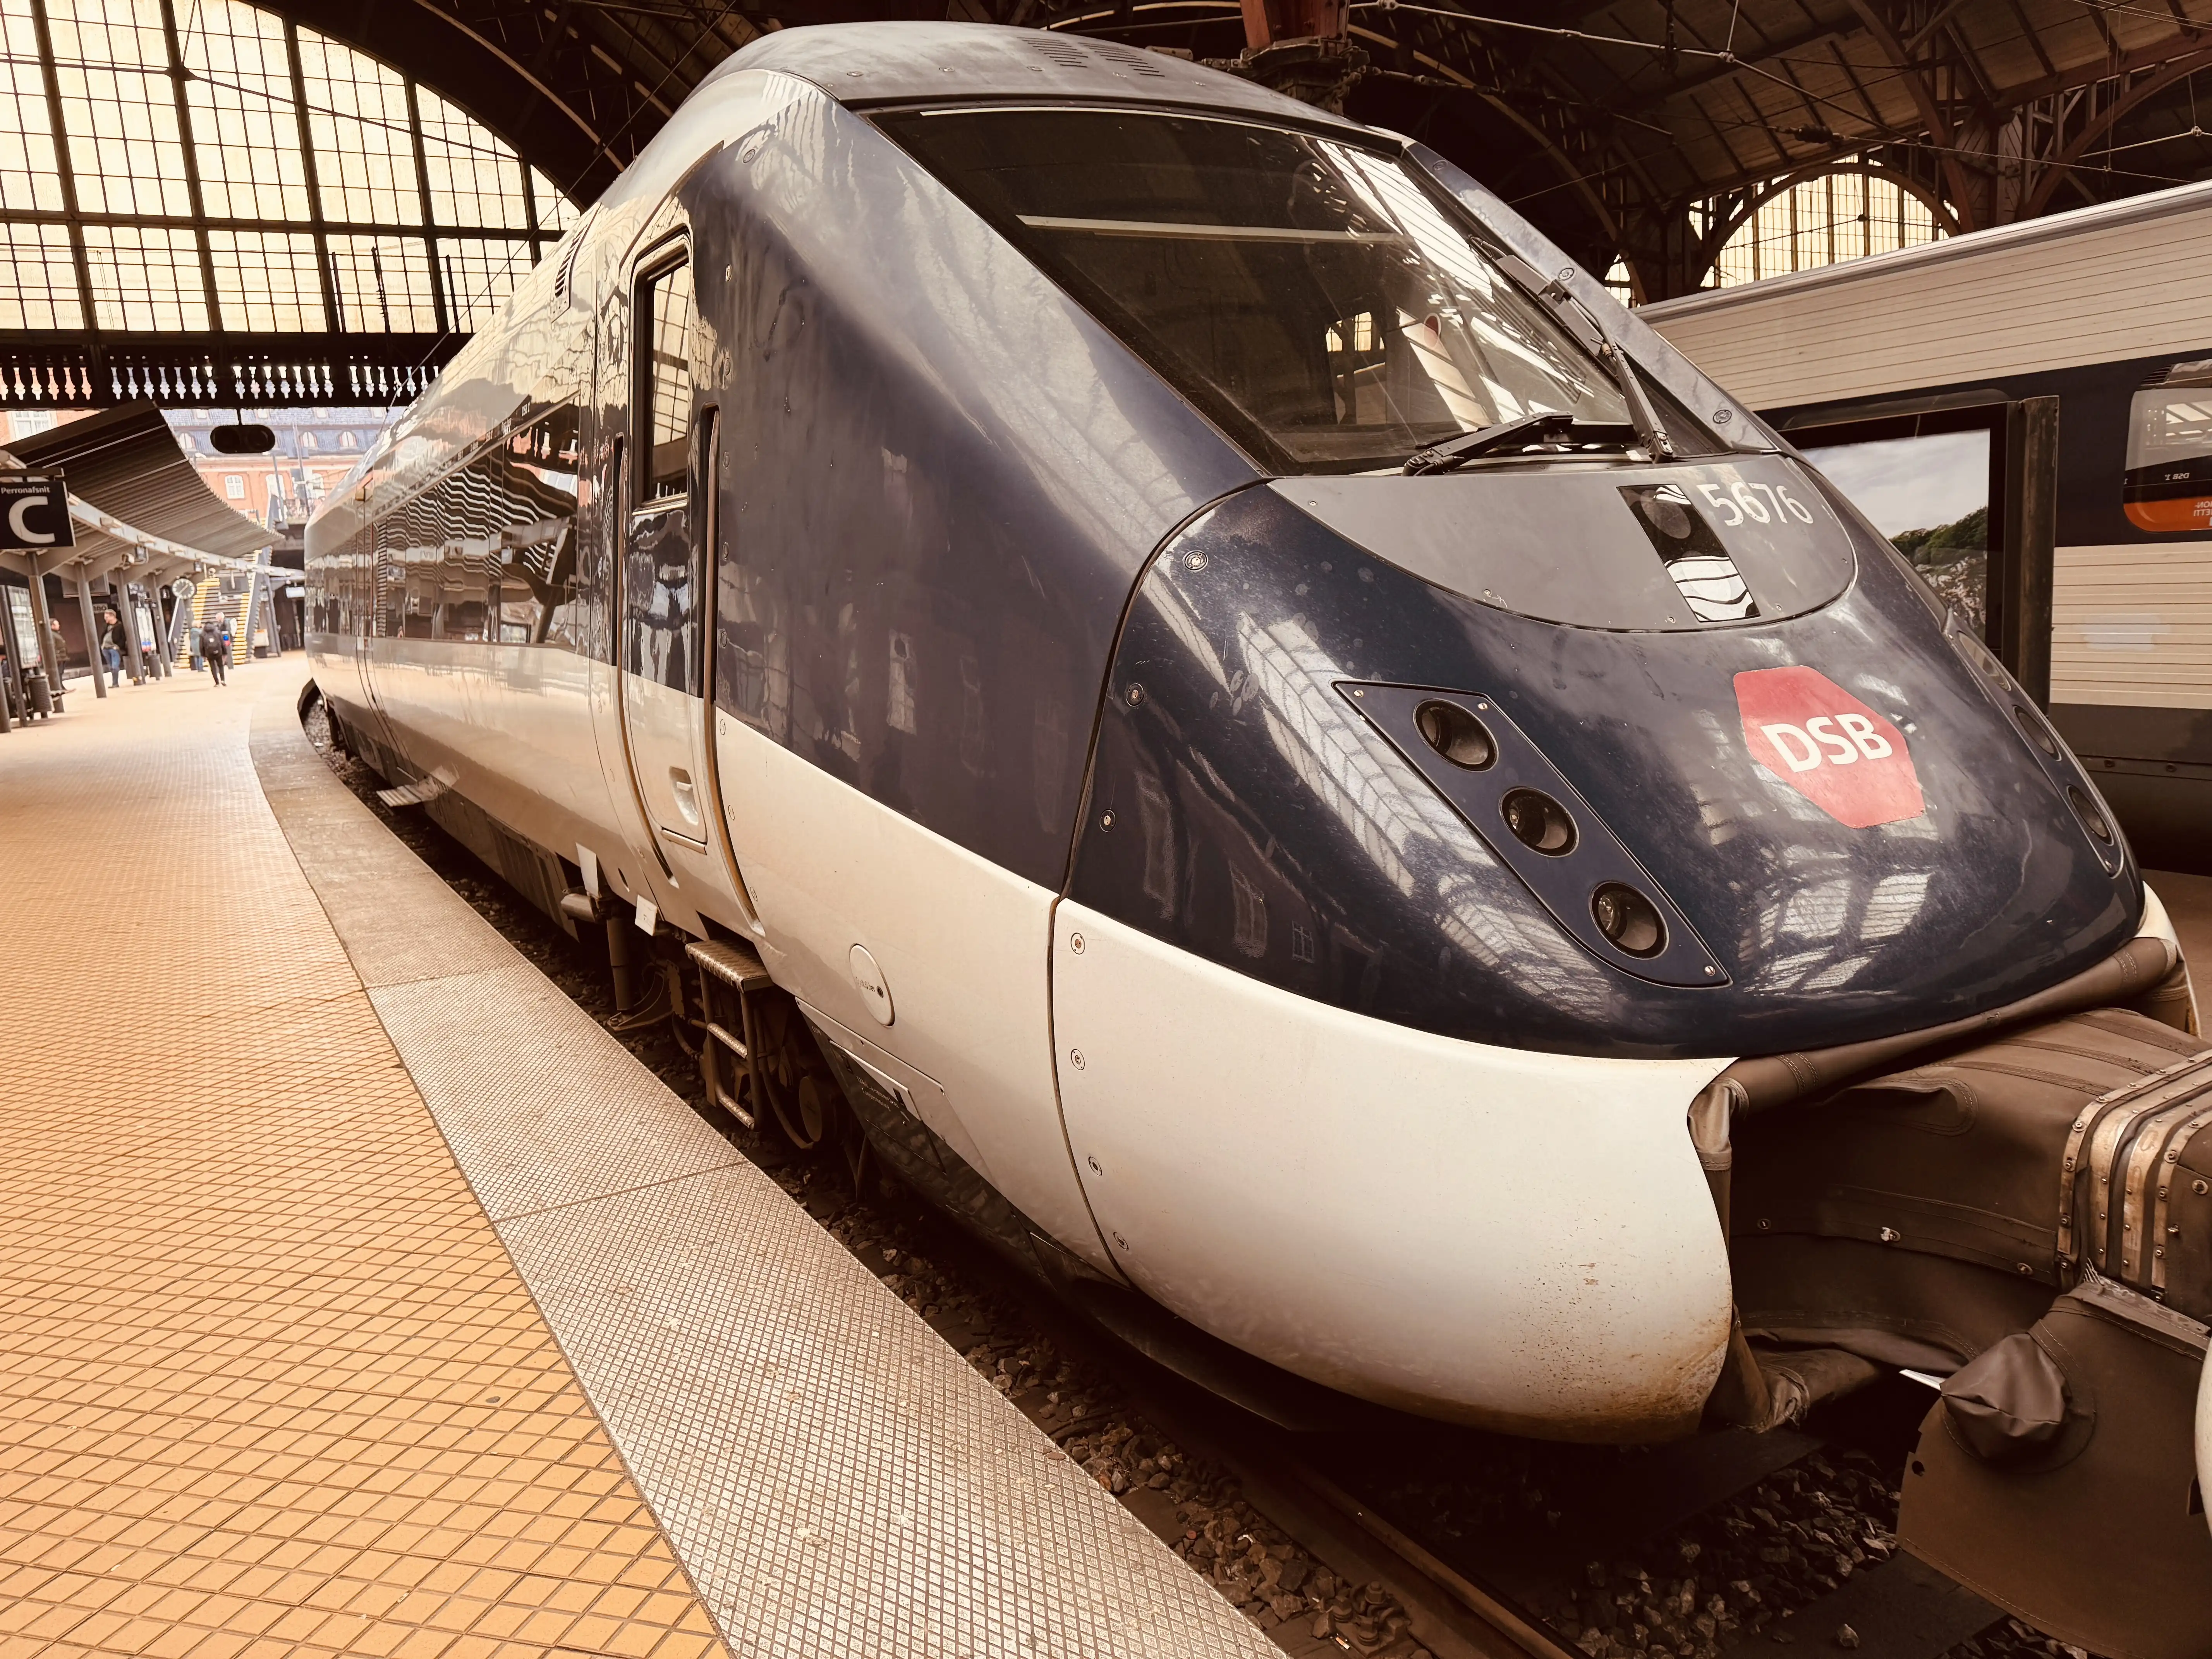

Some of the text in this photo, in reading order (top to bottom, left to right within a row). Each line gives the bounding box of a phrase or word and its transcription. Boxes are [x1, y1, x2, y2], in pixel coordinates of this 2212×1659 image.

[1, 486, 50, 494] Perronafsnit
[1696, 482, 1813, 526] 5676
[9, 496, 55, 543] C
[1760, 713, 1893, 773] DSB
